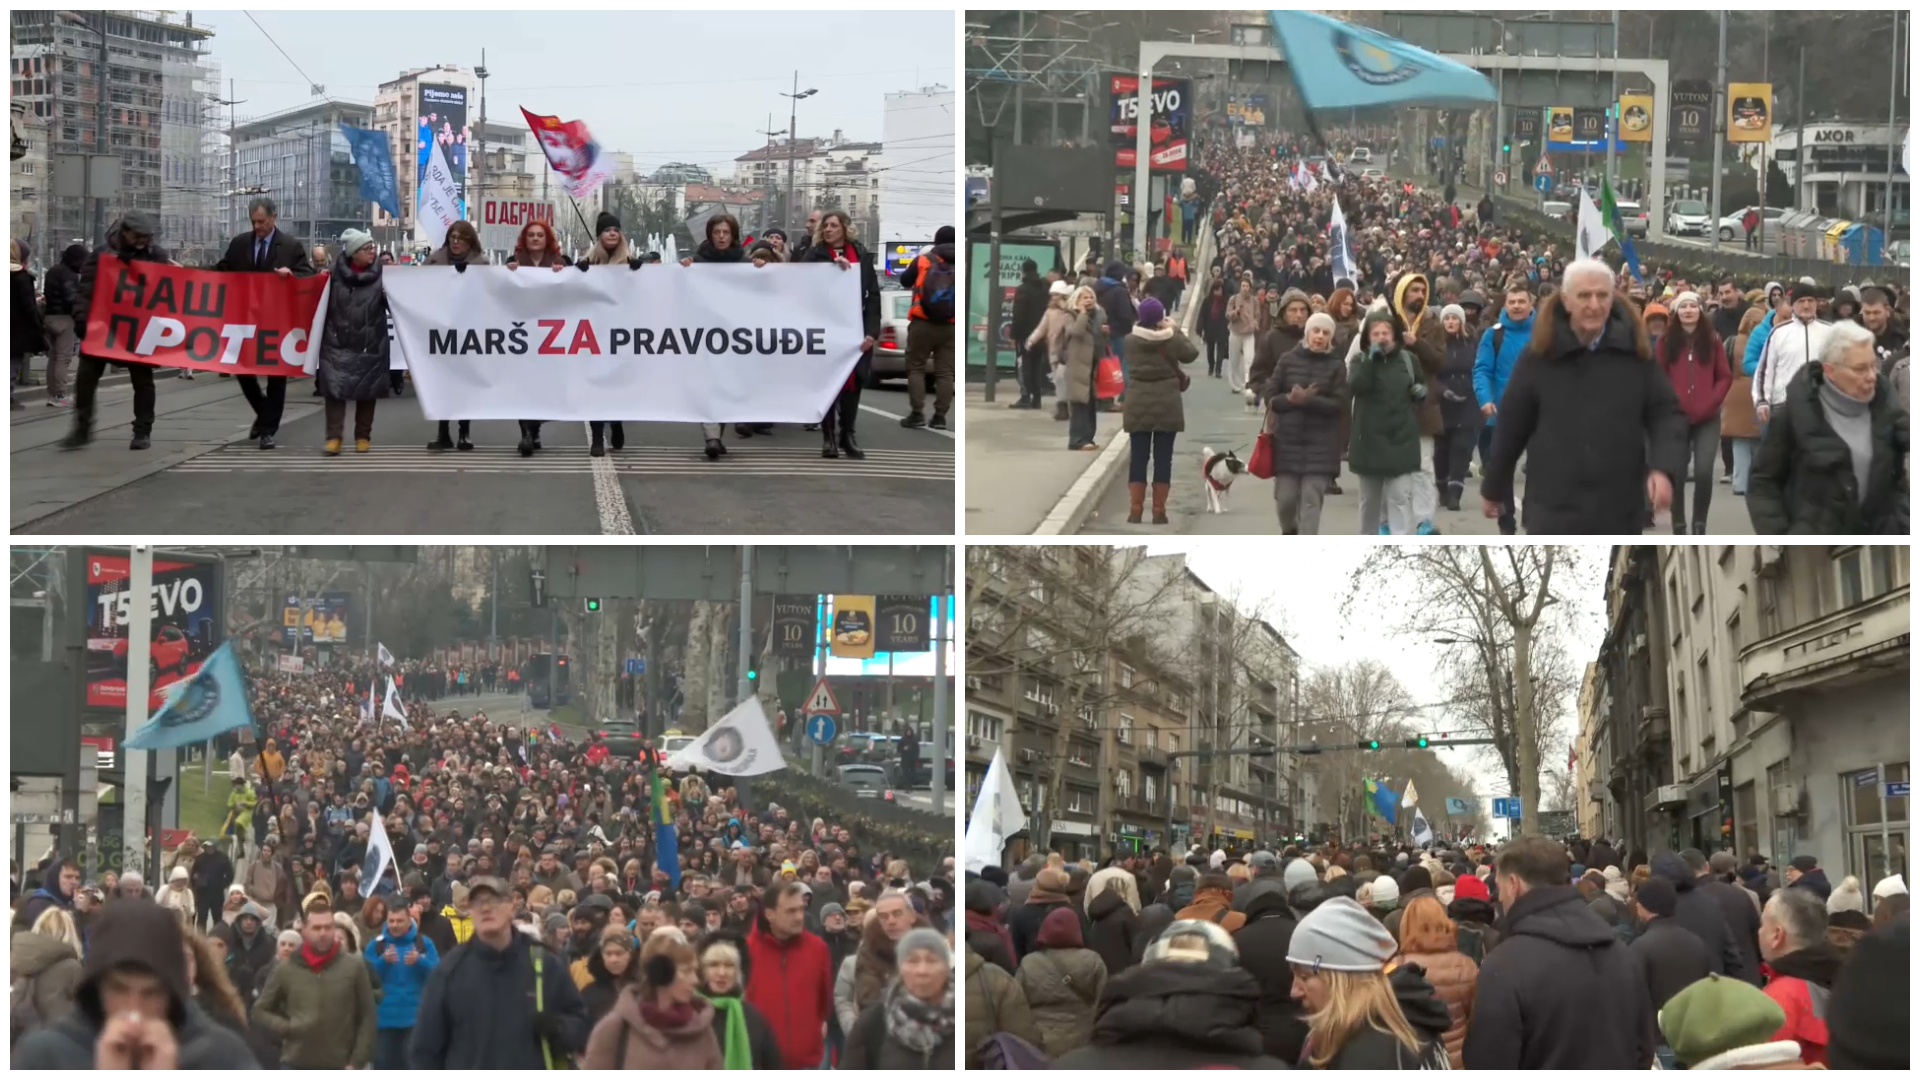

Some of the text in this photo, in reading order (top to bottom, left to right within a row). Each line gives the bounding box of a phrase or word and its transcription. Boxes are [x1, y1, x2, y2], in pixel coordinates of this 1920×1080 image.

[424, 89, 449, 99] Pijemo
[1674, 92, 1709, 101] YUTON
[1522, 120, 1533, 132] 10
[1583, 116, 1597, 130] 10
[1681, 111, 1699, 127] 10
[1815, 130, 1854, 143] AXOR
[113, 269, 226, 319] НАШ
[428, 321, 529, 355] MARŠ
[537, 319, 601, 355] ZA
[609, 327, 827, 355] PRAVOSUĐE
[776, 604, 812, 615] YUTON
[892, 613, 917, 634] 10
[783, 624, 802, 641] 10
